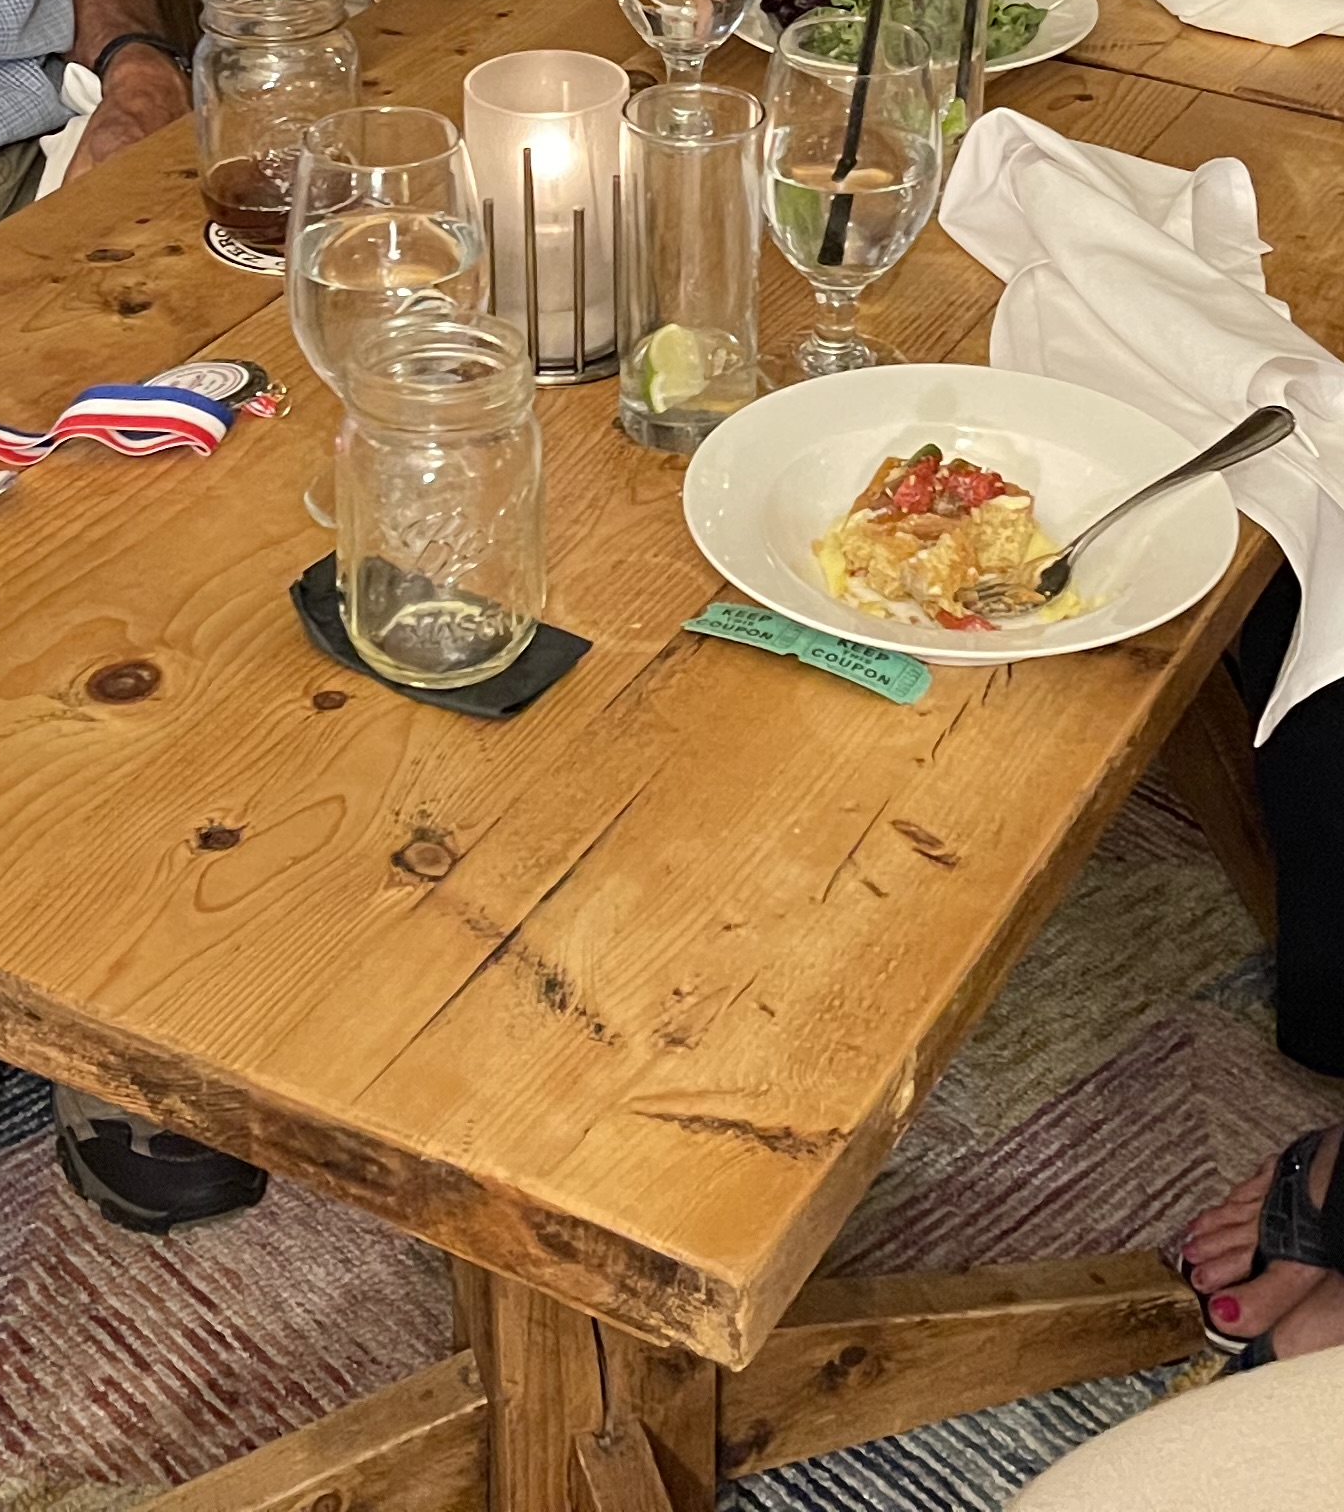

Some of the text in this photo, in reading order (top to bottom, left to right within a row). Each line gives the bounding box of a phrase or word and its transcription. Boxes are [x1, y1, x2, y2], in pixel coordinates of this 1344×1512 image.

[215, 228, 265, 264] ZERO
[721, 609, 773, 622] KEEP
[696, 618, 774, 640] COUPON
[837, 638, 890, 661] KEEP
[811, 648, 891, 686] COUPON
